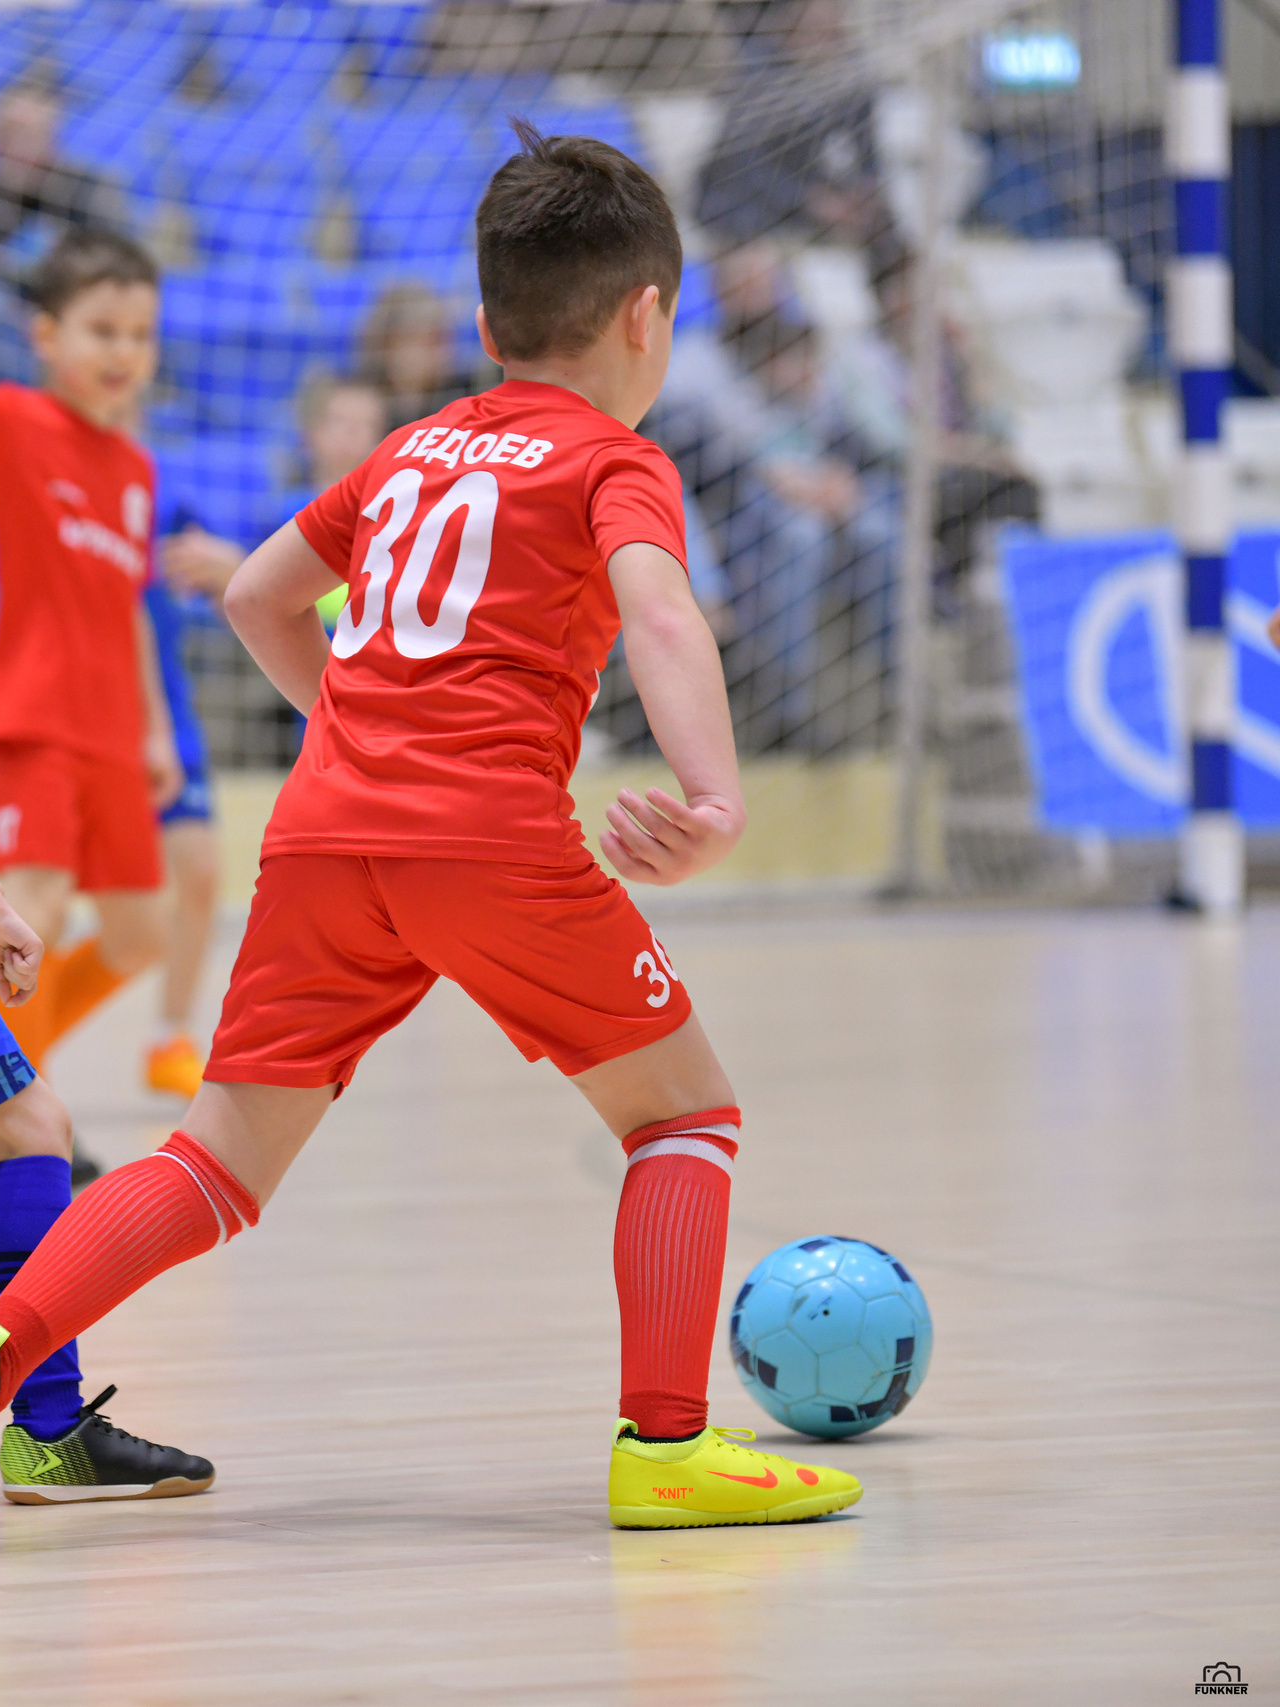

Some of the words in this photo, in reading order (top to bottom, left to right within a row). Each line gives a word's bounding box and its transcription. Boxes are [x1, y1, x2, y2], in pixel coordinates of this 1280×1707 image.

[393, 426, 554, 470] БЕДОЕВ
[331, 468, 499, 659] 30
[652, 1487, 694, 1500] "KNIT"
